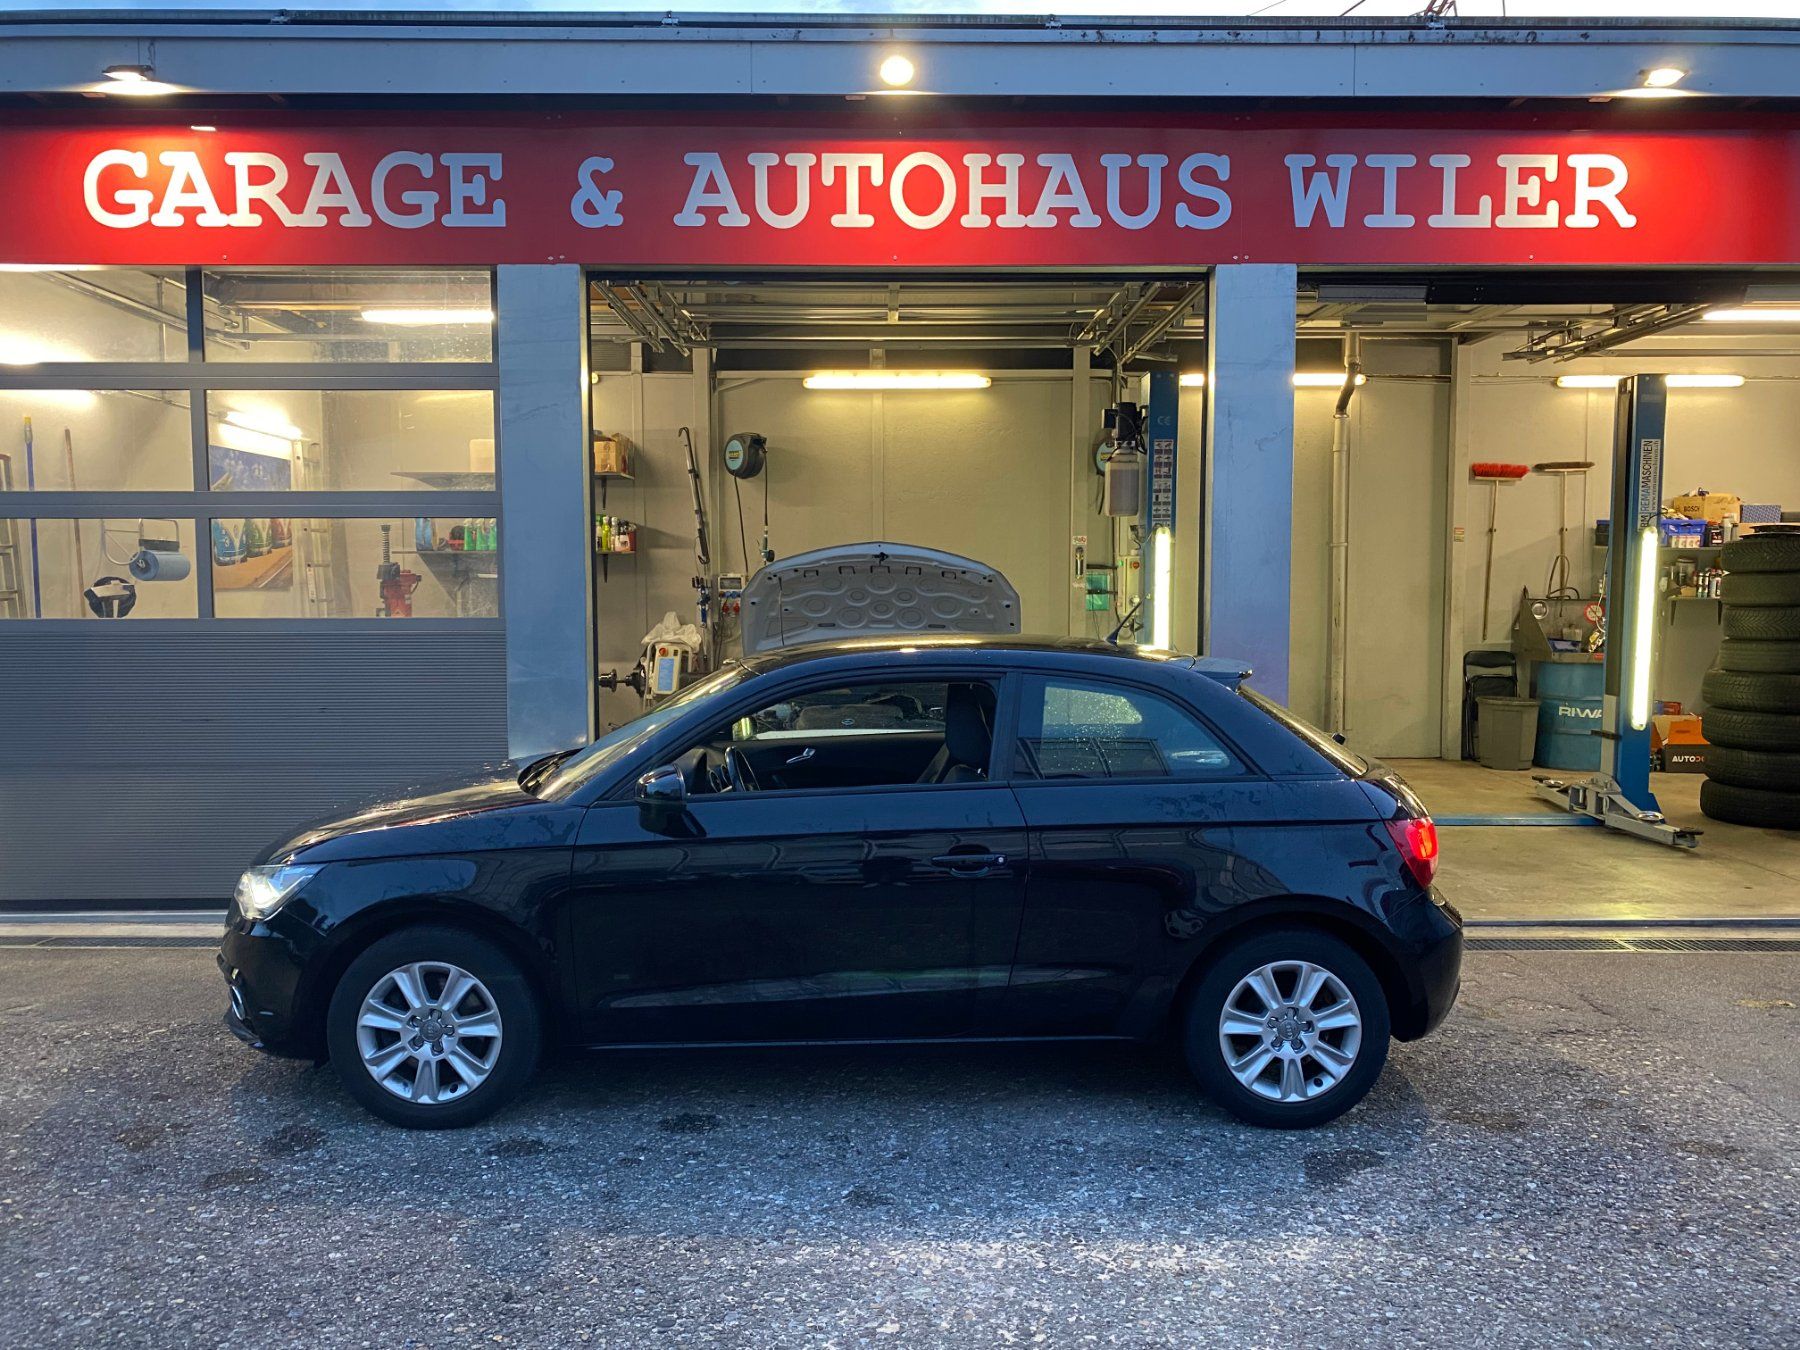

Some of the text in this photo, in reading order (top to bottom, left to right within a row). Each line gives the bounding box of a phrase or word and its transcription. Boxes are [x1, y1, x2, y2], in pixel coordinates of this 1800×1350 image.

[84, 150, 1637, 229] GARAGE & AUTOHAUS WILER
[1641, 440, 1653, 512] REMAMASCHINEN
